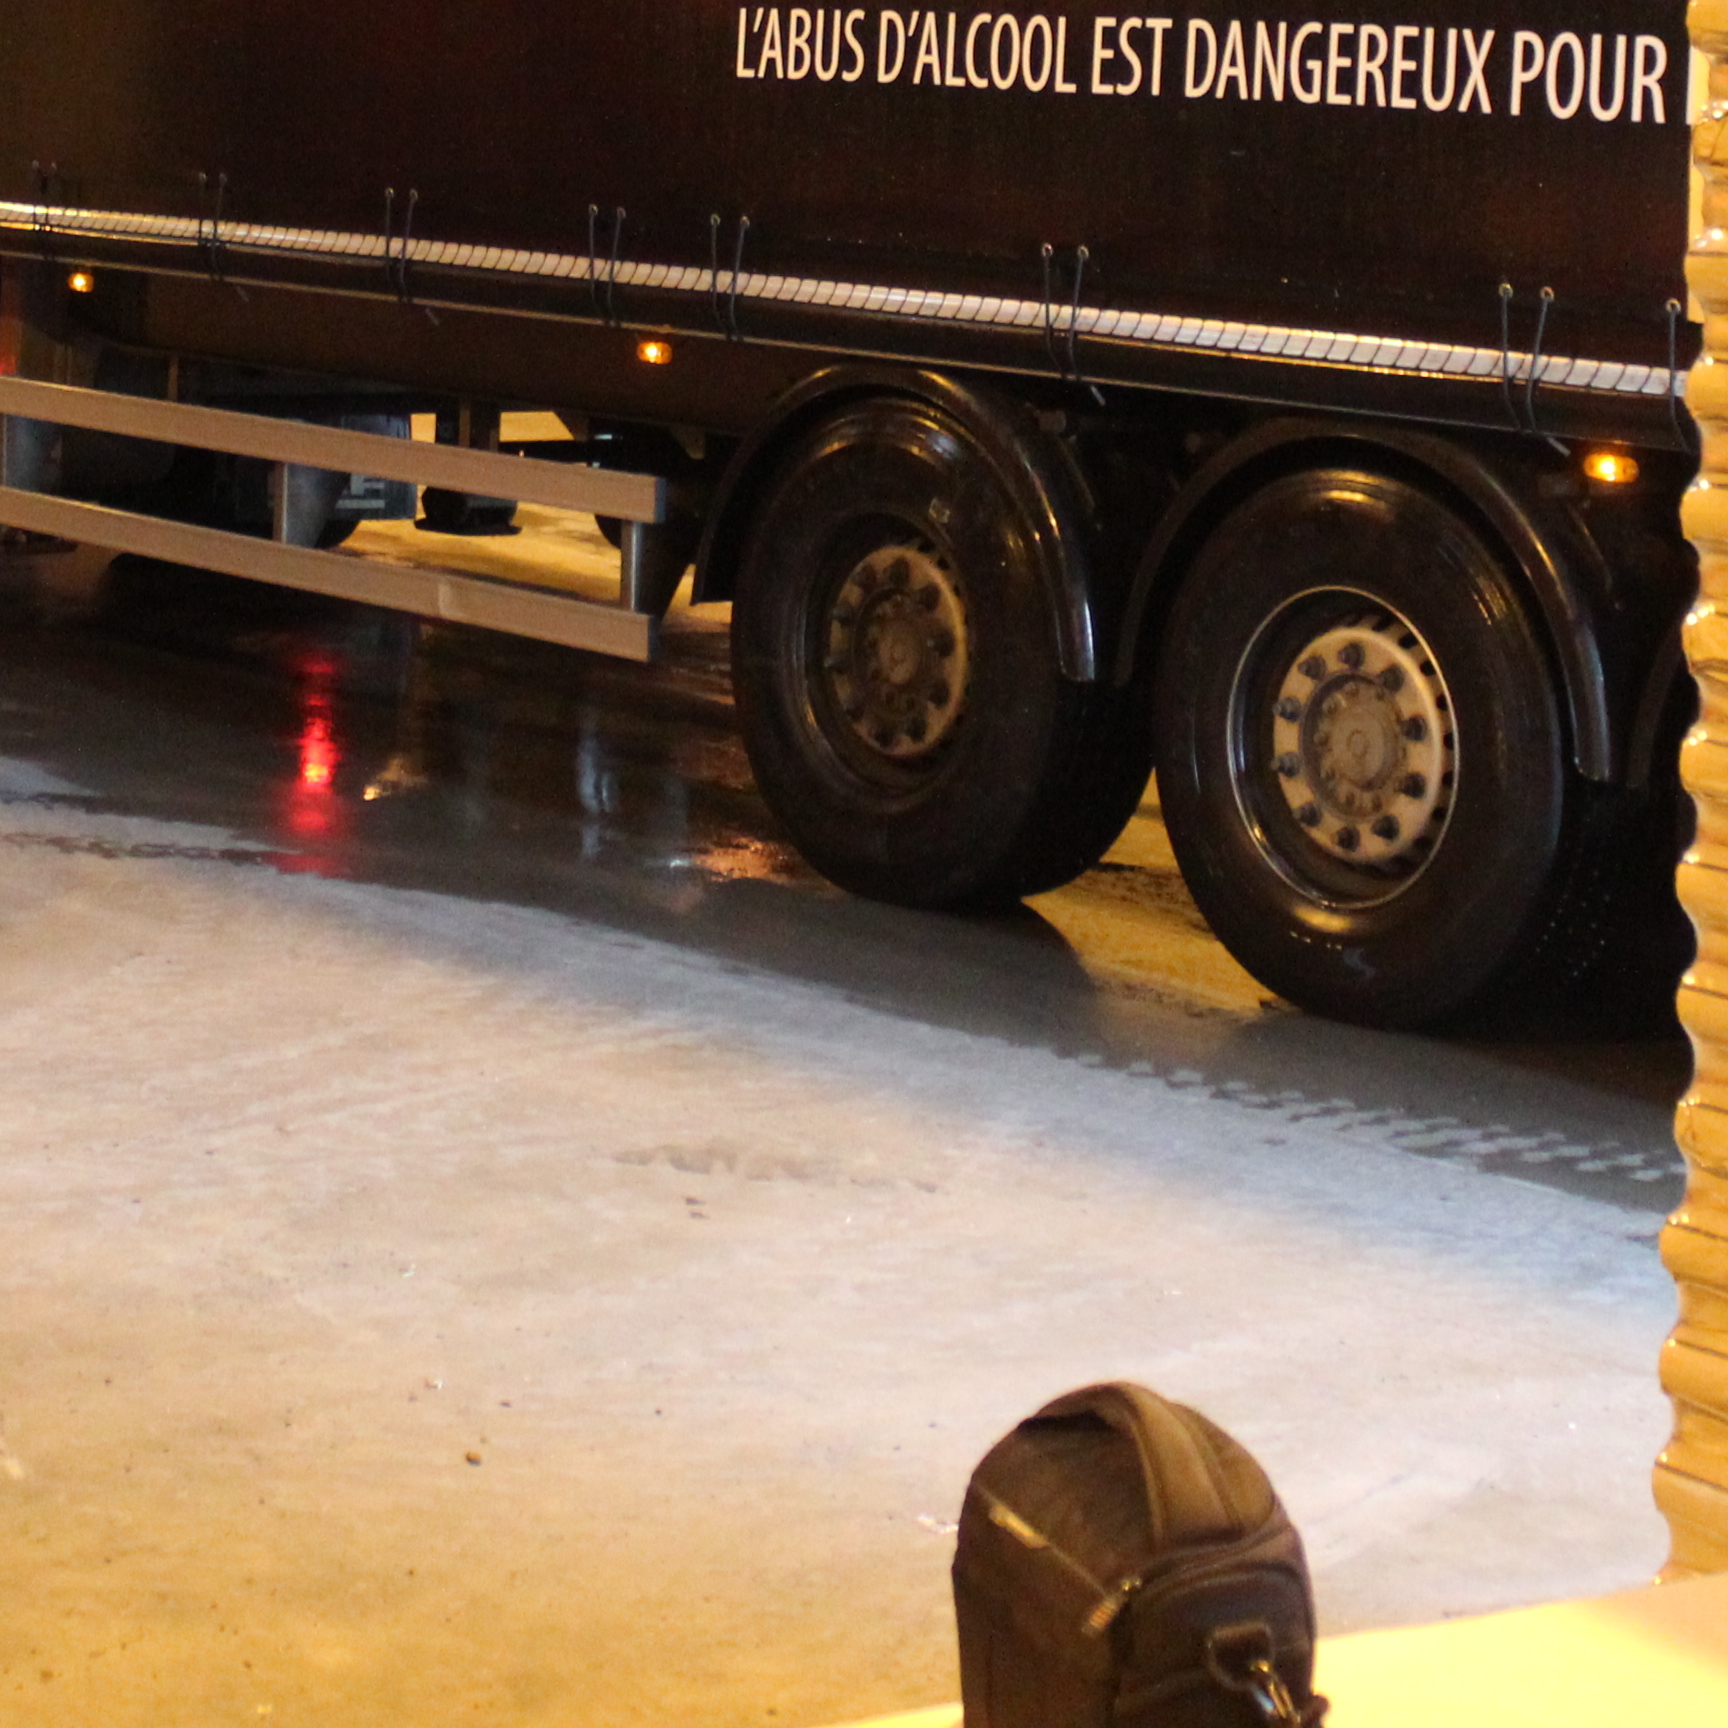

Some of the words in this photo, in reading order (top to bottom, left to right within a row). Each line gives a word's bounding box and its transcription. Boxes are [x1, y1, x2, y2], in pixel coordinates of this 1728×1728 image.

[735, 7, 866, 82] L'ABUS
[877, 9, 1077, 93] D'ALCOOL
[1091, 16, 1174, 97] EST
[1184, 18, 1495, 115] DANGEREUX
[1510, 29, 1668, 125] POUR
